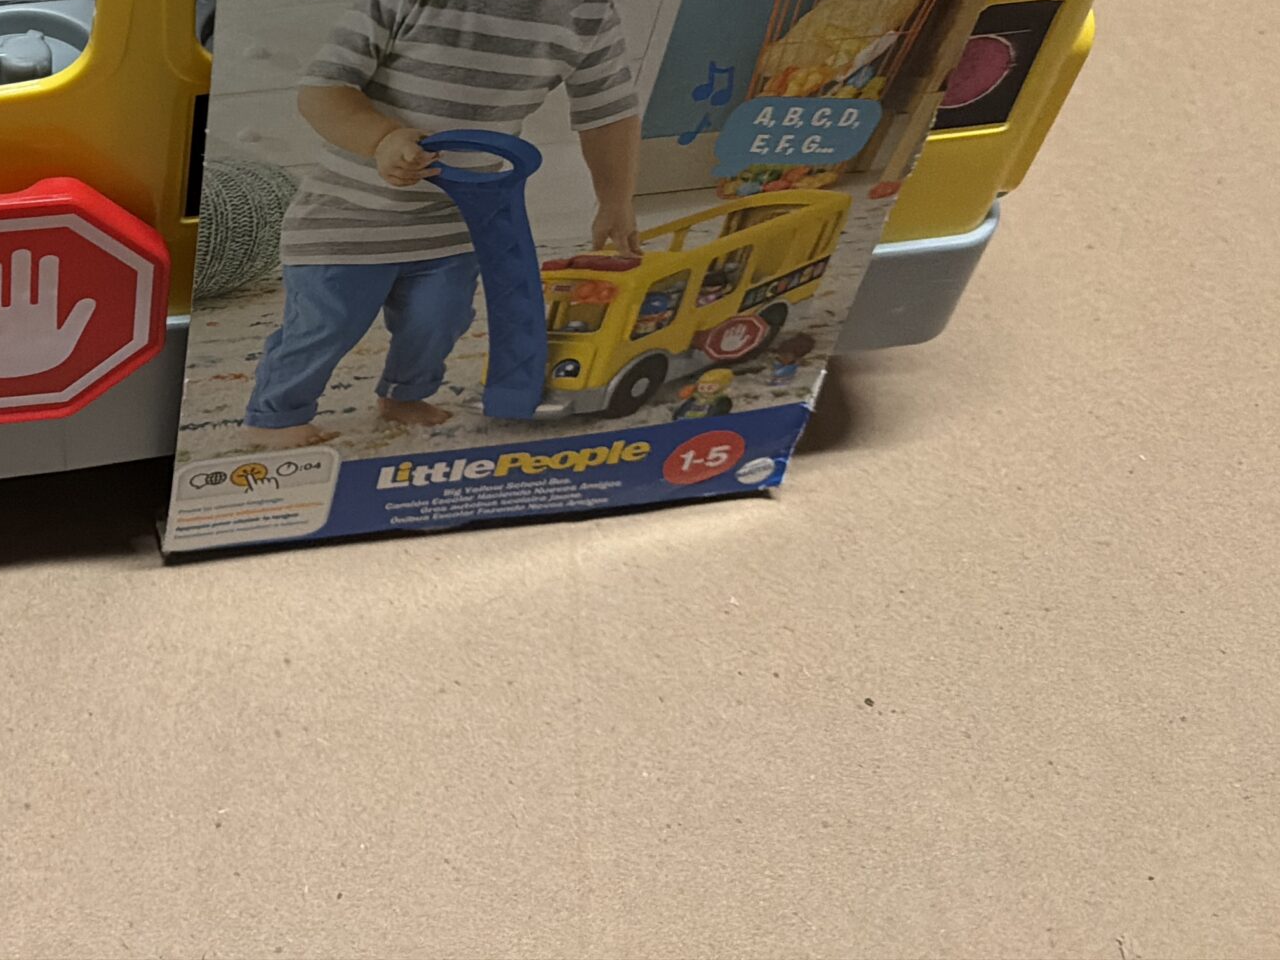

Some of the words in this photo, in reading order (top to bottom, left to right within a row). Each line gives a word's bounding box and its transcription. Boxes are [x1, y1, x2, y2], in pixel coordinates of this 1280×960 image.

[753, 106, 776, 128] A,
[782, 107, 804, 128] B,
[811, 107, 833, 128] C,
[837, 108, 860, 129] D,
[749, 134, 769, 155] E,
[775, 134, 795, 155] F,
[801, 135, 835, 154] G...
[680, 444, 731, 472] 1-5
